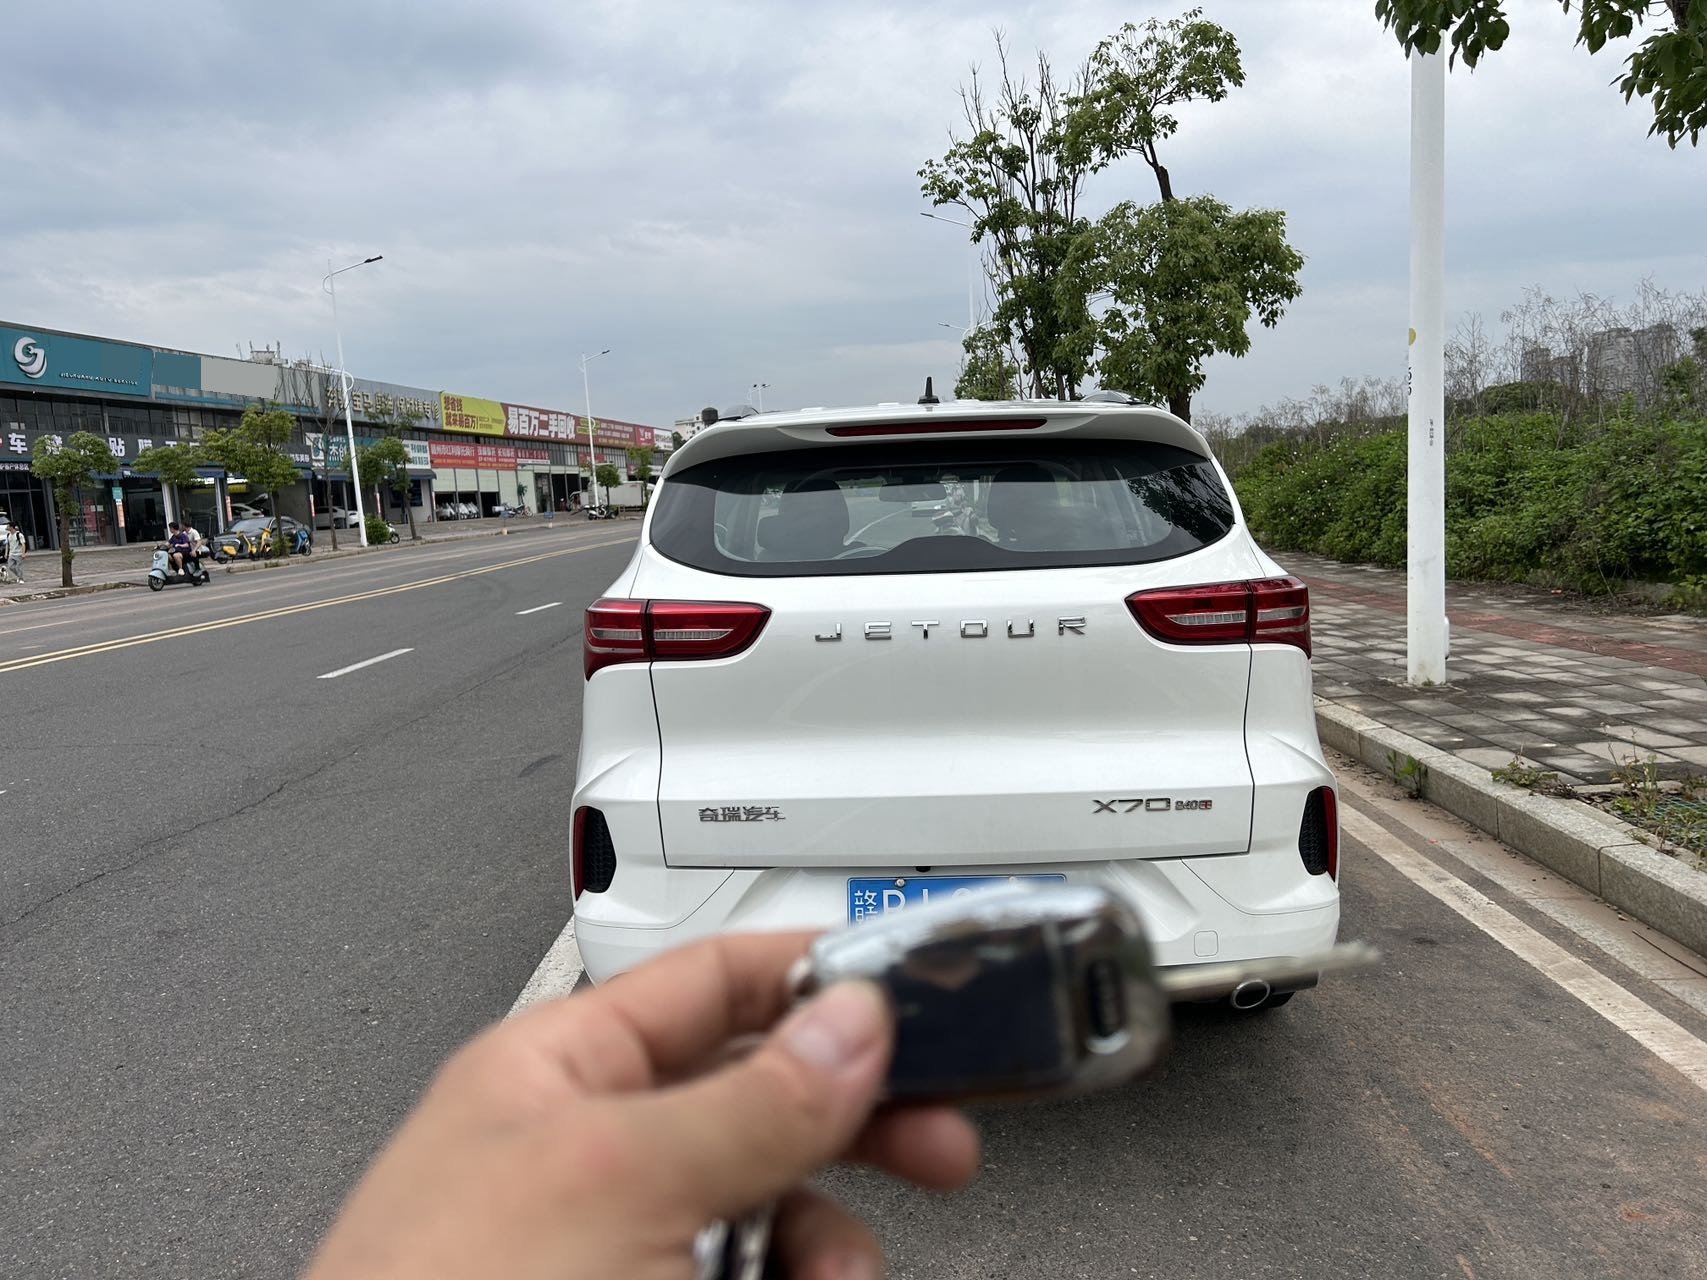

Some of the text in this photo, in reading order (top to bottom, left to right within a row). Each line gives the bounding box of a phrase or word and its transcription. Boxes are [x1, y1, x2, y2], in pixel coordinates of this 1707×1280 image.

[507, 406, 576, 439] 易百万二手回收
[815, 616, 1086, 642] JETOUR
[698, 806, 786, 822] 奇瑞汽车
[1092, 798, 1171, 813] X70
